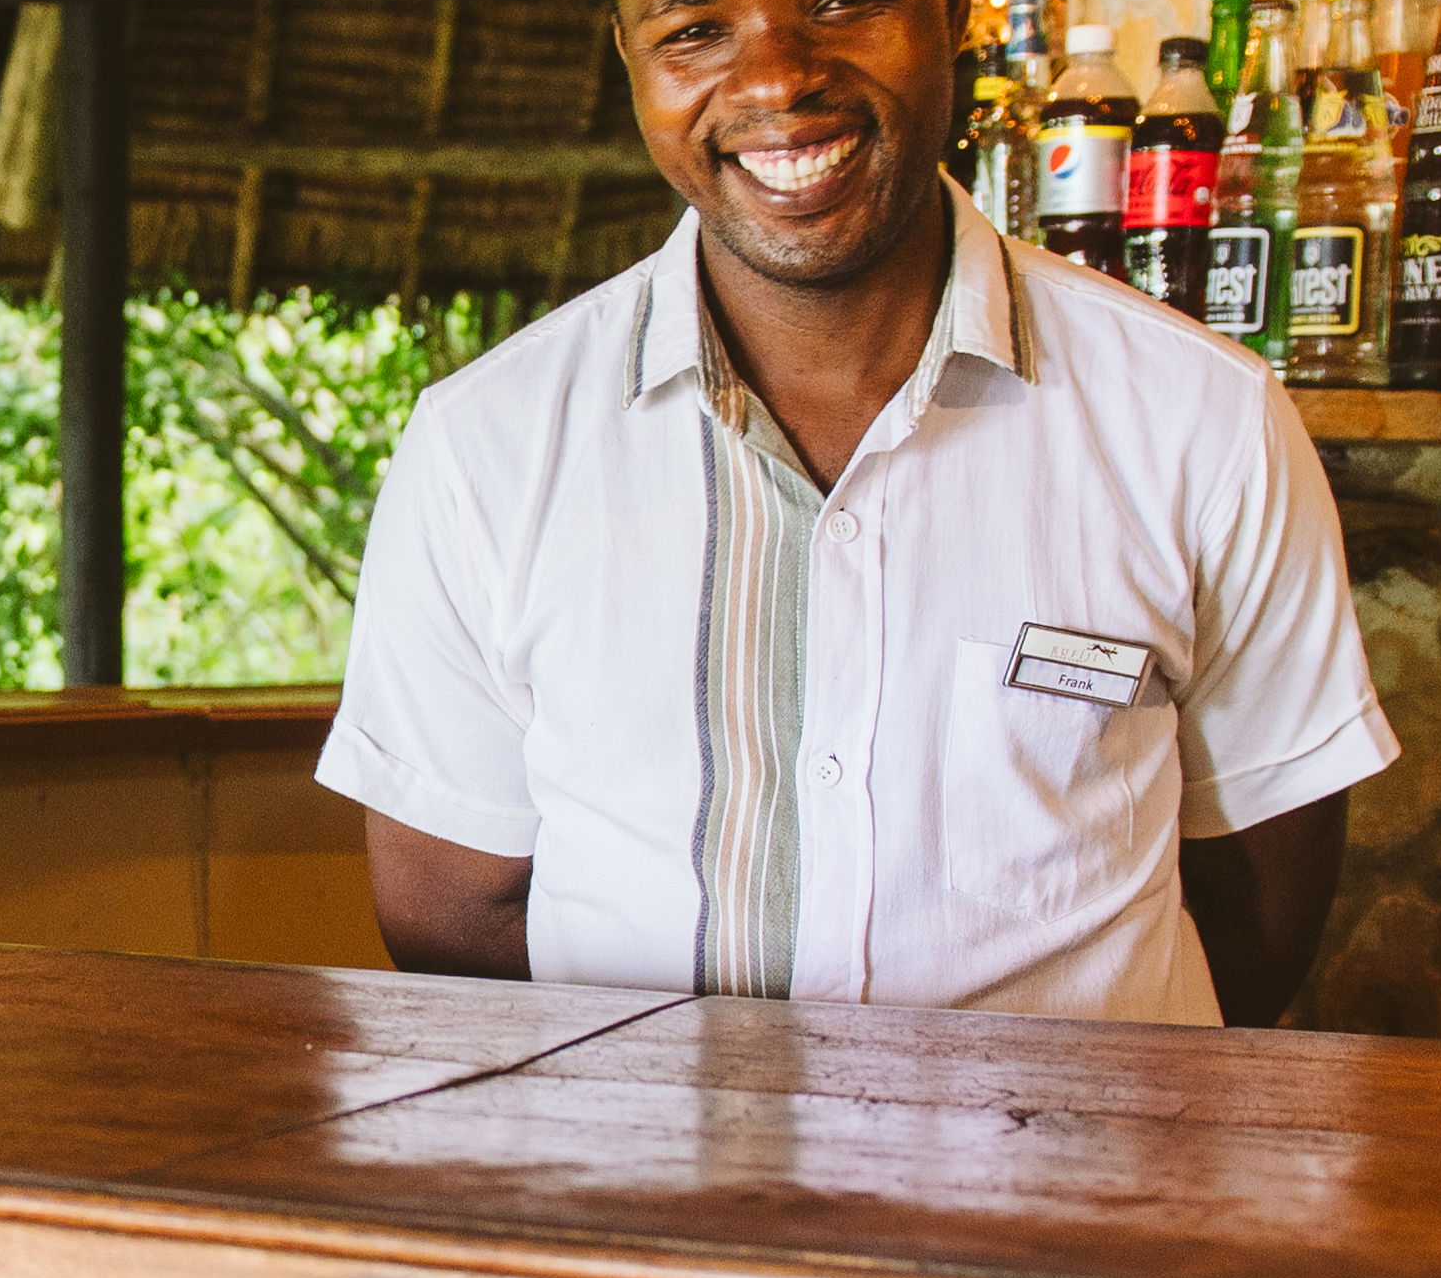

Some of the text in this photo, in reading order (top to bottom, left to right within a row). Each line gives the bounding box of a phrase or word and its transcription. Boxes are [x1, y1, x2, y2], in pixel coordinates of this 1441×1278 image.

[1205, 263, 1257, 305] rest
[1290, 263, 1352, 306] rest
[1051, 646, 1098, 662] RUFIJI
[1058, 674, 1094, 691] Frank
